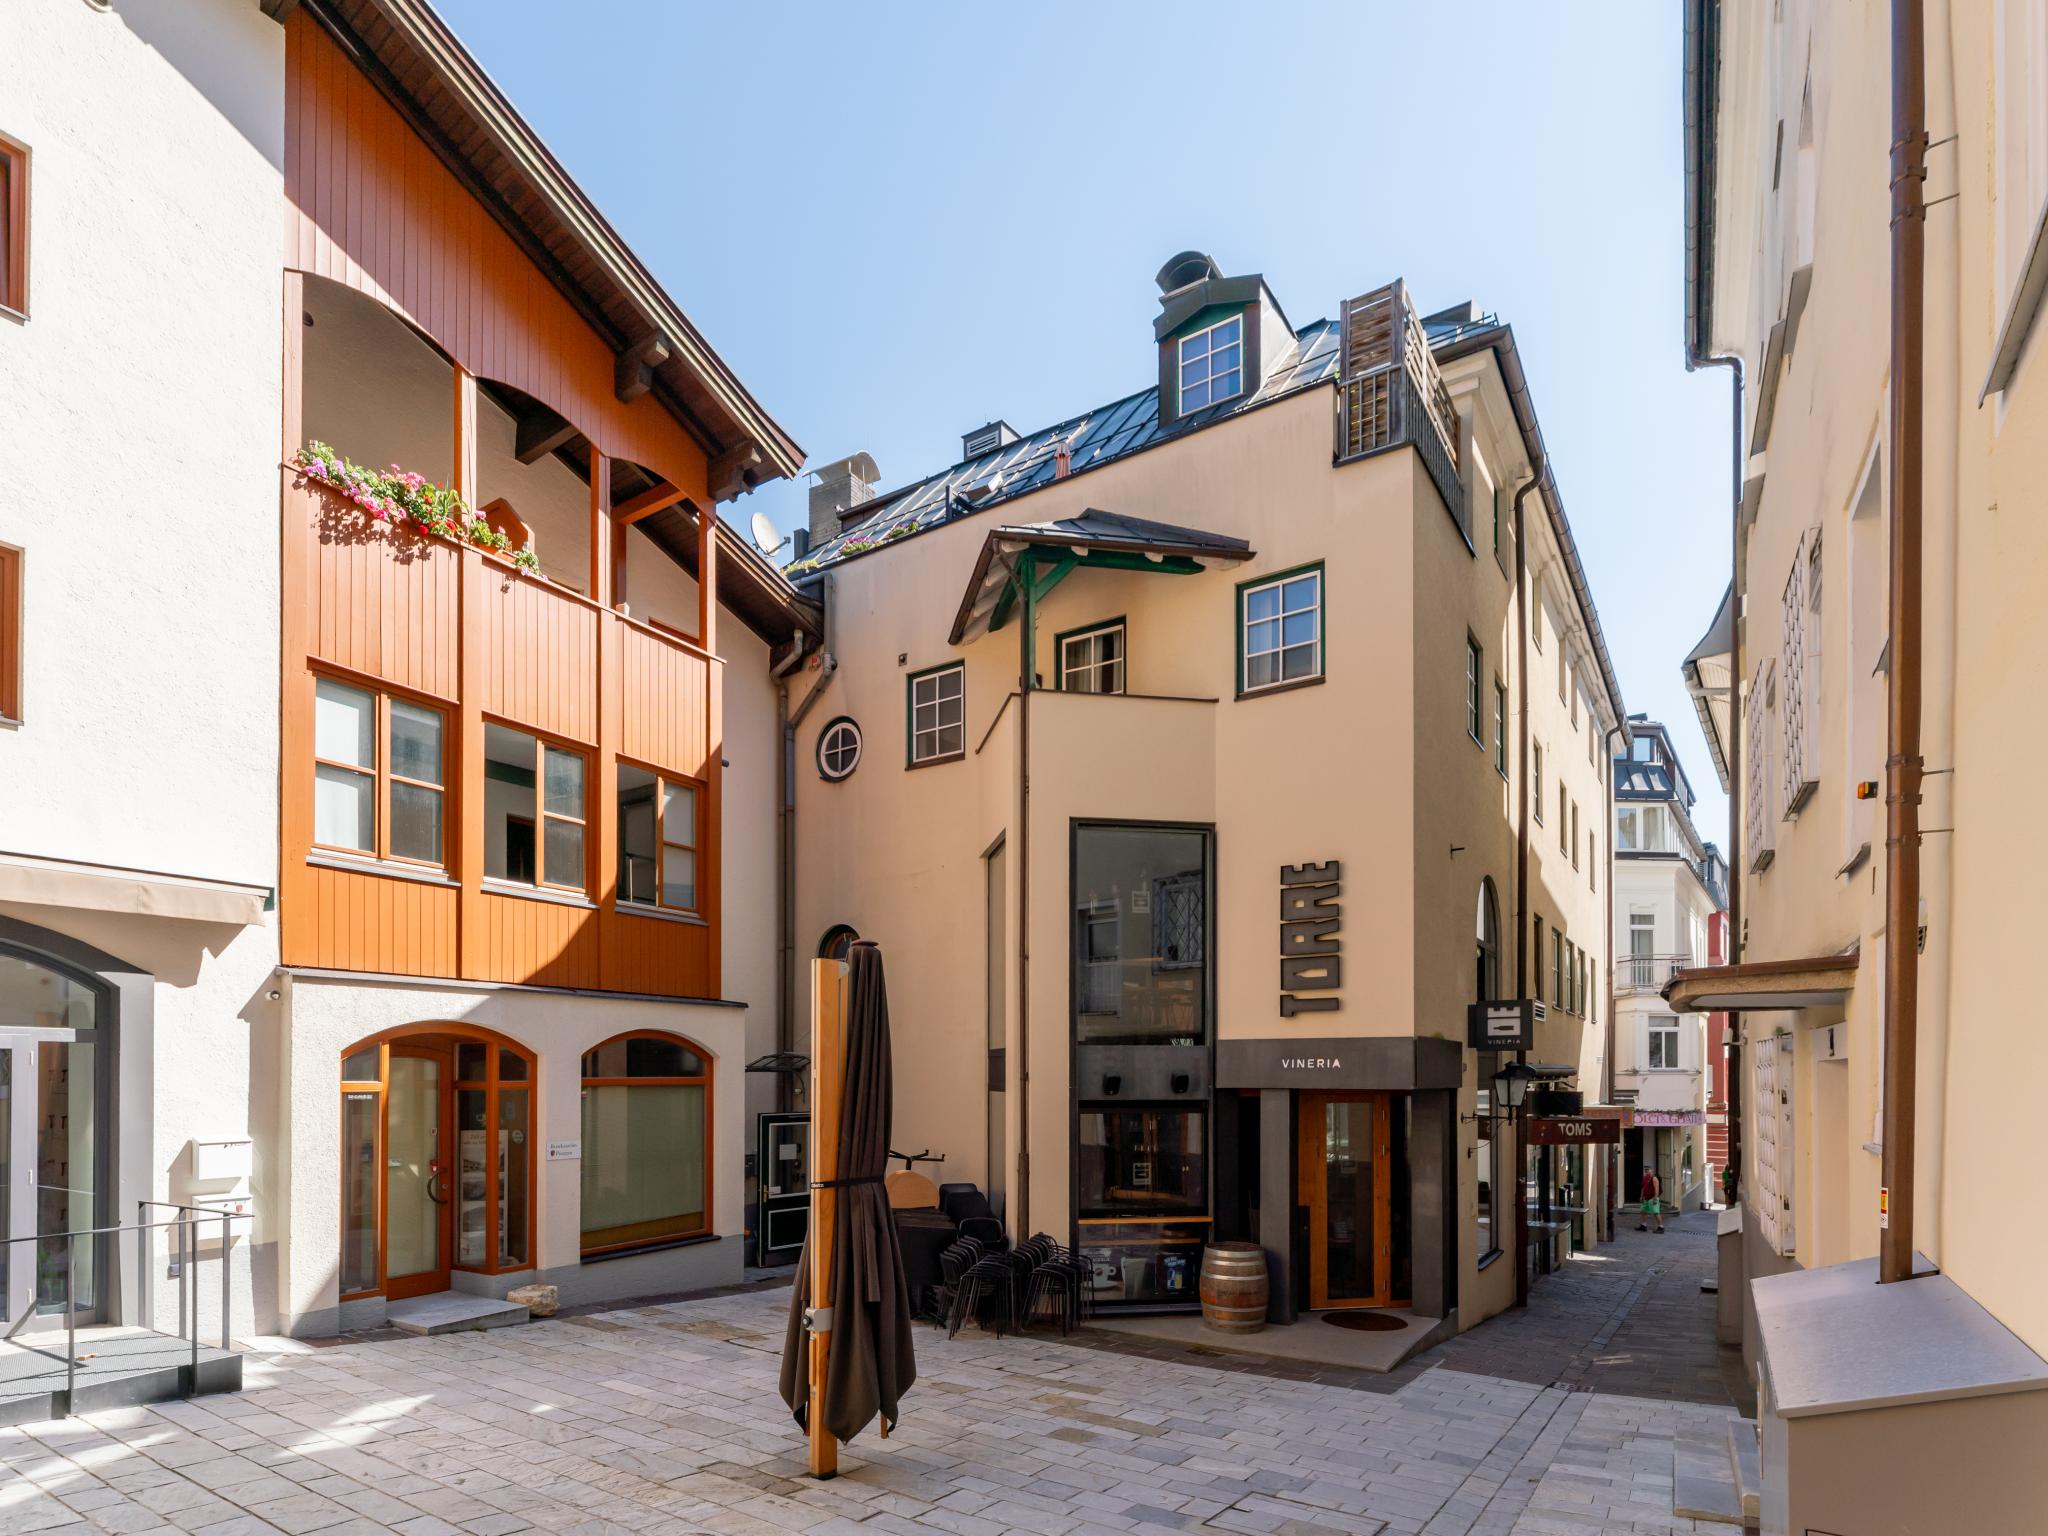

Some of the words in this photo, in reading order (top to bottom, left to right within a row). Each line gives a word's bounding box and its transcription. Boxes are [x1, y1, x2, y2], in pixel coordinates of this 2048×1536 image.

[1280, 860, 1340, 1018] TORRE
[1281, 1058, 1342, 1069] VINERIA
[1557, 1122, 1593, 1137] TOMS
